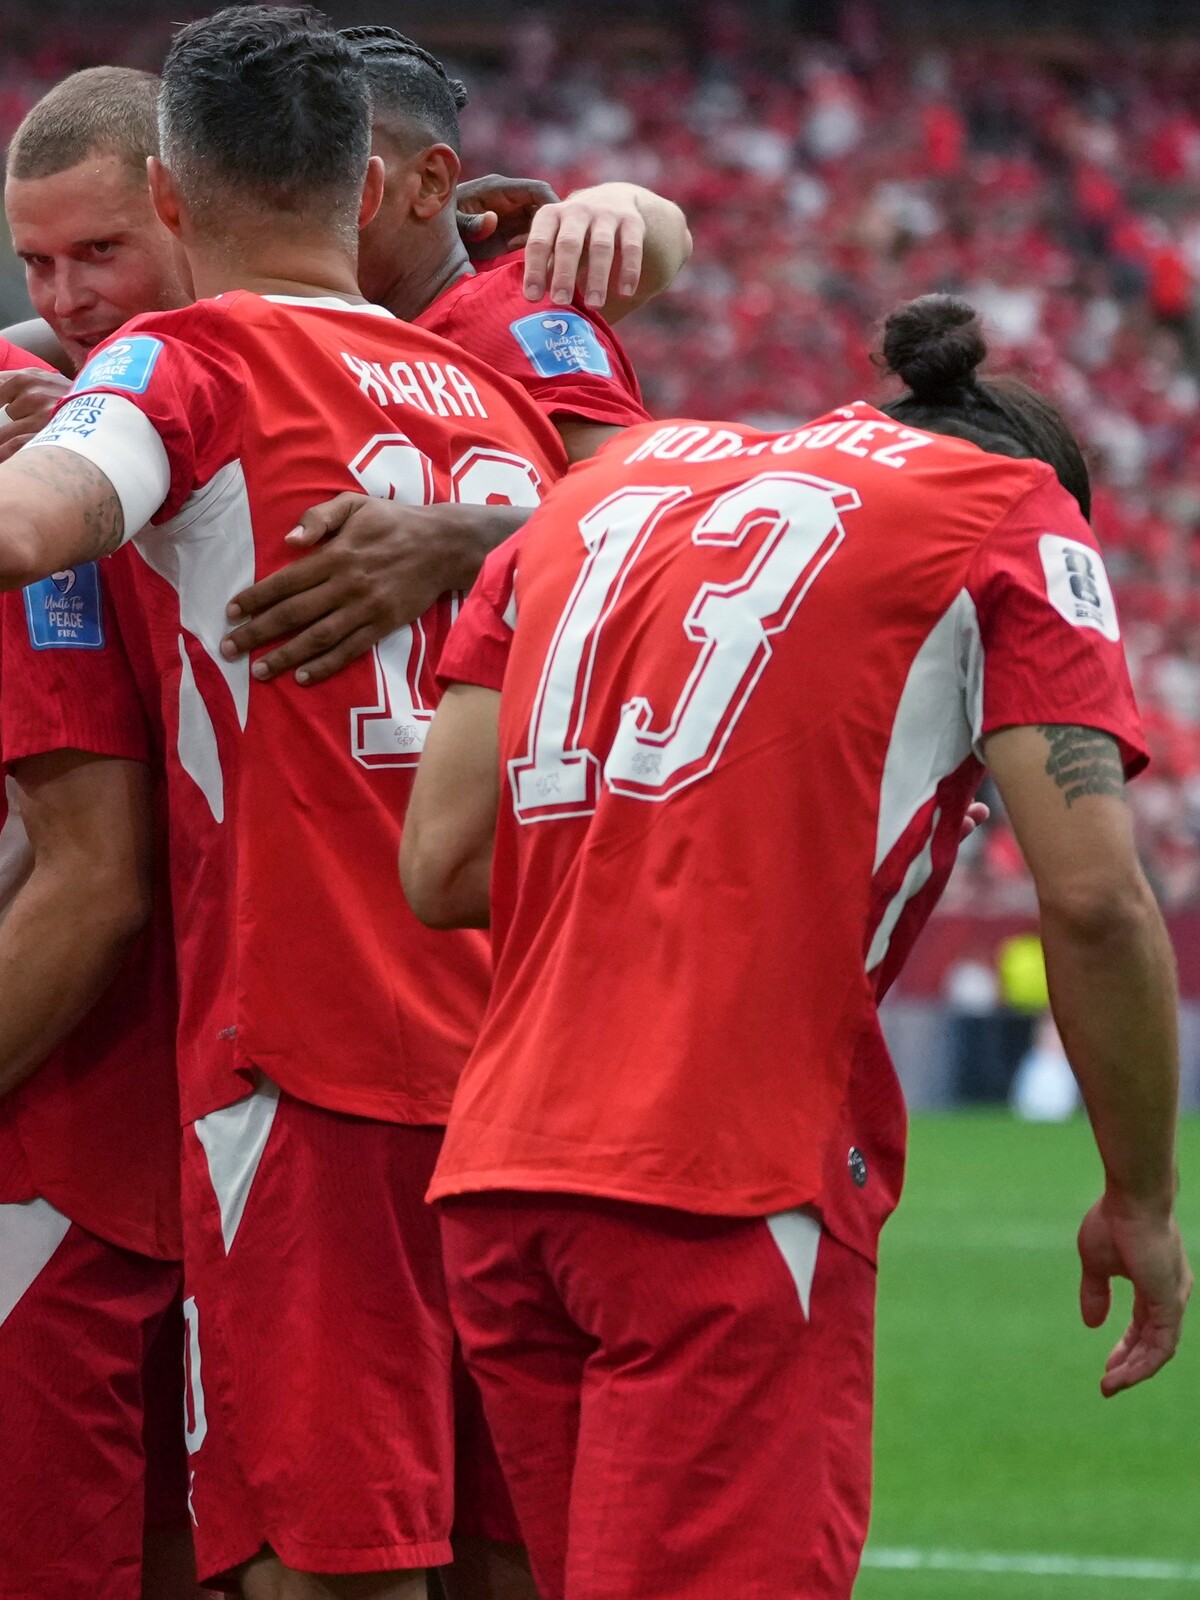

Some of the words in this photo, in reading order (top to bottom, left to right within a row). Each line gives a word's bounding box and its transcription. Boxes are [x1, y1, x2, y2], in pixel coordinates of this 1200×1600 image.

[552, 346, 591, 362] PEACE
[44, 594, 70, 611] Unite
[71, 596, 85, 610] For
[49, 612, 84, 628] PEACE
[57, 630, 78, 638] FIFA
[507, 471, 862, 825] 13
